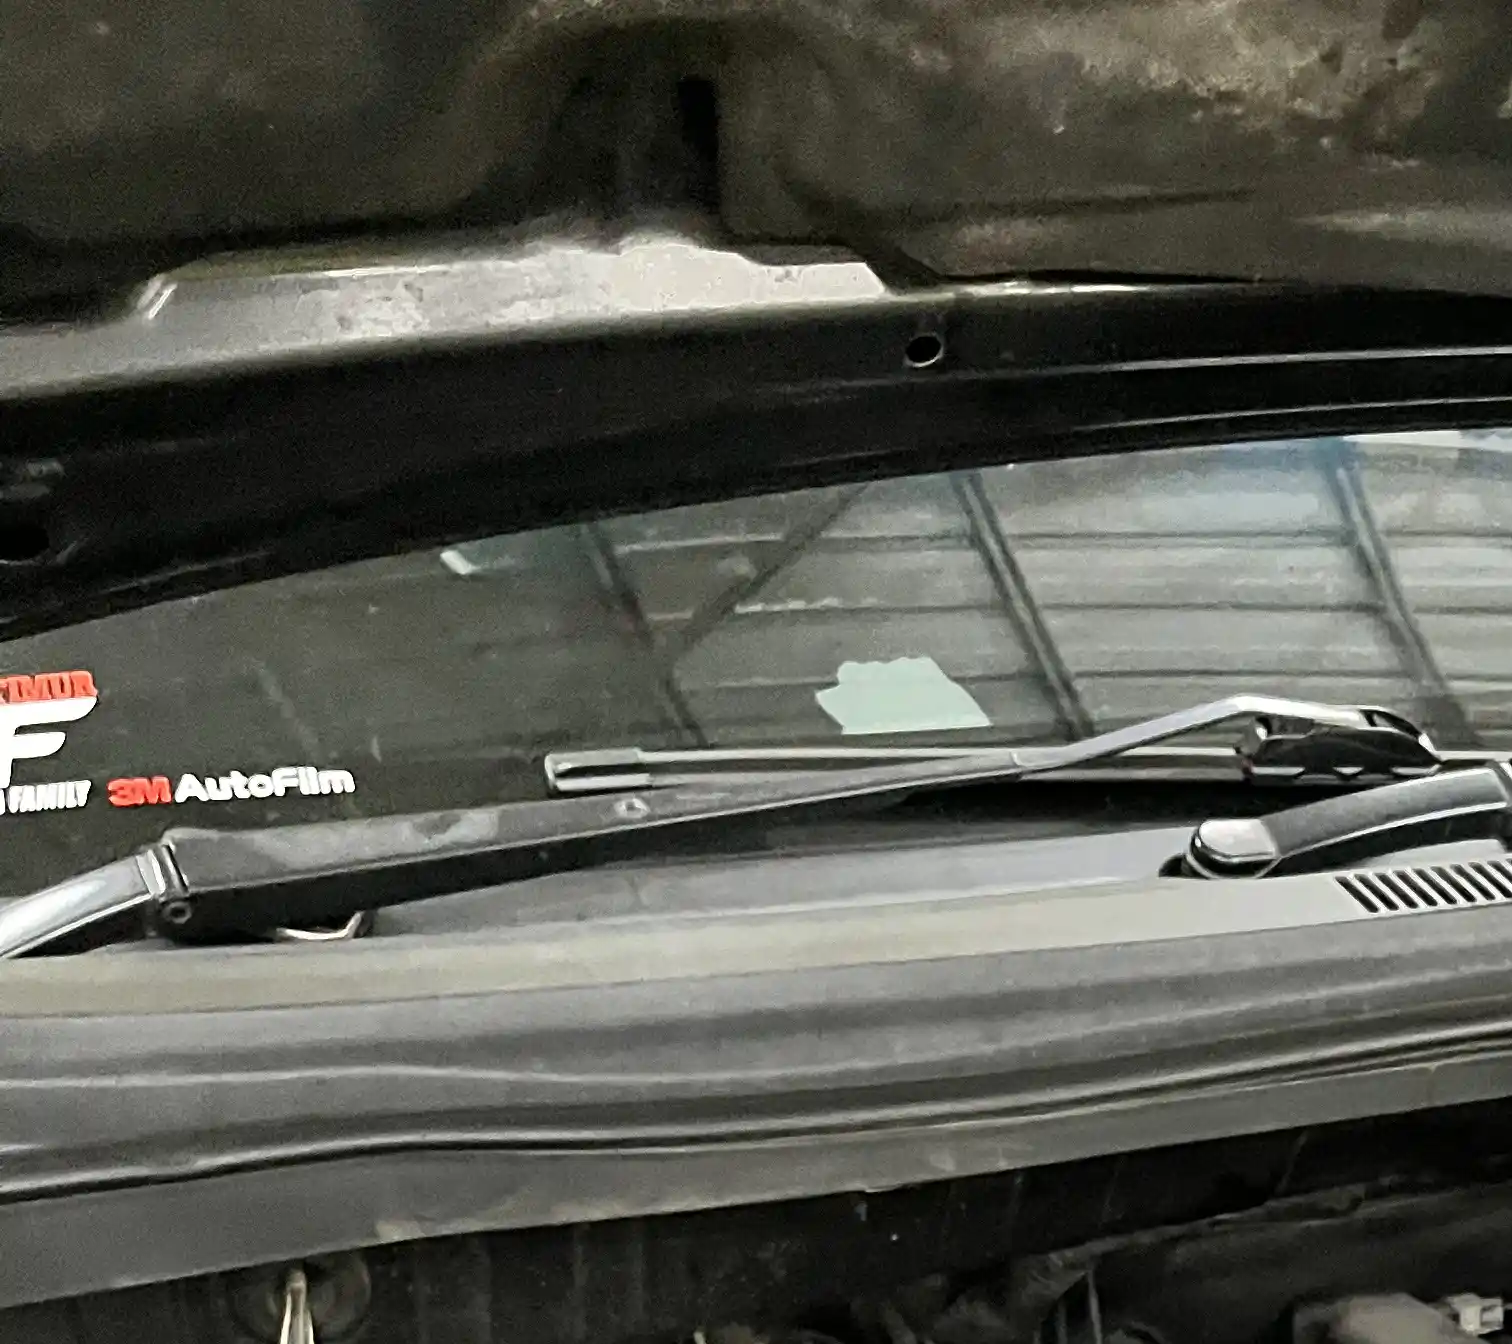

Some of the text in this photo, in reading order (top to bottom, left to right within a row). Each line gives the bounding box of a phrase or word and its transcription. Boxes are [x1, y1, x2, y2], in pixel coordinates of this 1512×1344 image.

[9, 779, 92, 814] FAMILY
[107, 766, 356, 807] 3M AutoFilm
